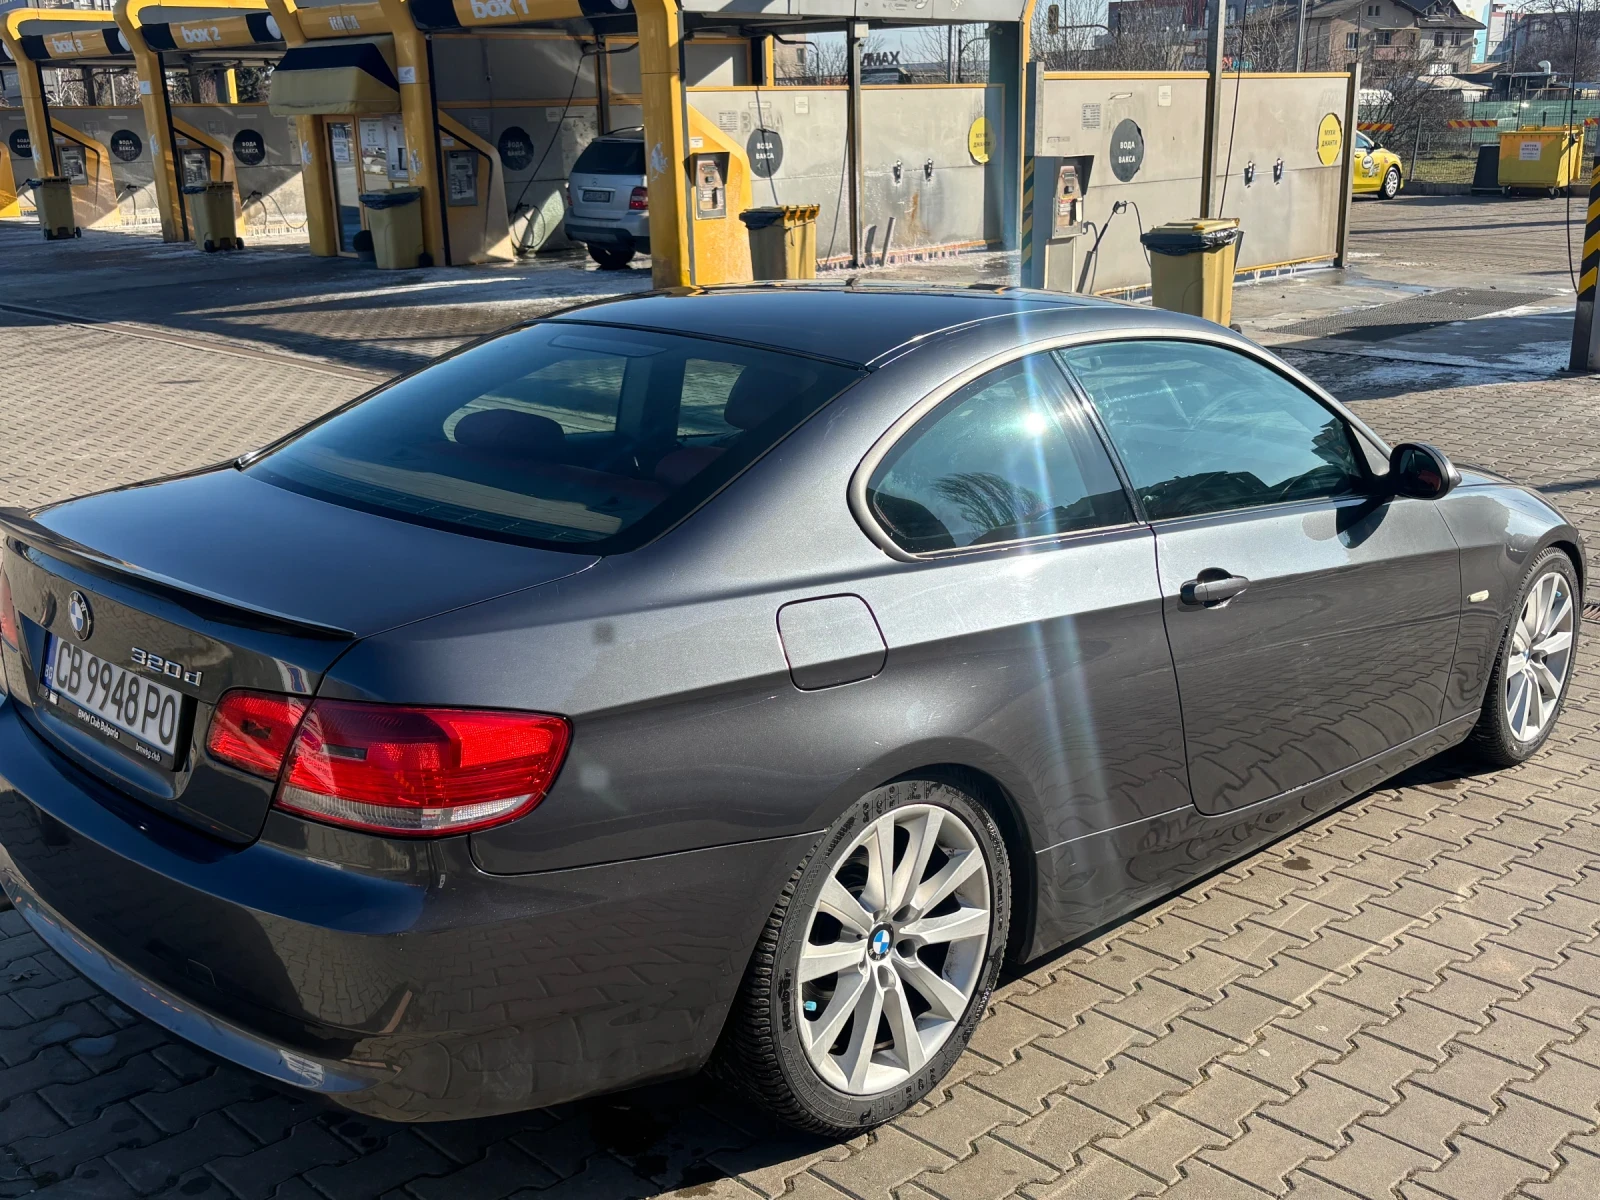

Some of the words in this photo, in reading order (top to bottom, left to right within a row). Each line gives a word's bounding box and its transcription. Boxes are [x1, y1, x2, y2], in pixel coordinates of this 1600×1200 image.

[470, 0, 516, 18] box
[518, 0, 529, 14] 1
[181, 25, 212, 43] box
[211, 26, 221, 40] 2
[52, 37, 77, 53] box
[75, 39, 84, 52] 3
[1120, 140, 1136, 150] ВОДА
[1118, 155, 1136, 164] ВАКСА
[44, 664, 54, 680] BG
[131, 647, 202, 686] 320d
[56, 641, 82, 696] CB
[86, 656, 140, 727] 9948
[141, 683, 176, 745] PO
[77, 708, 91, 723] BMW
[90, 714, 101, 730] Club
[100, 720, 119, 740] Bulgaria
[135, 742, 161, 762] bmwbg.club
